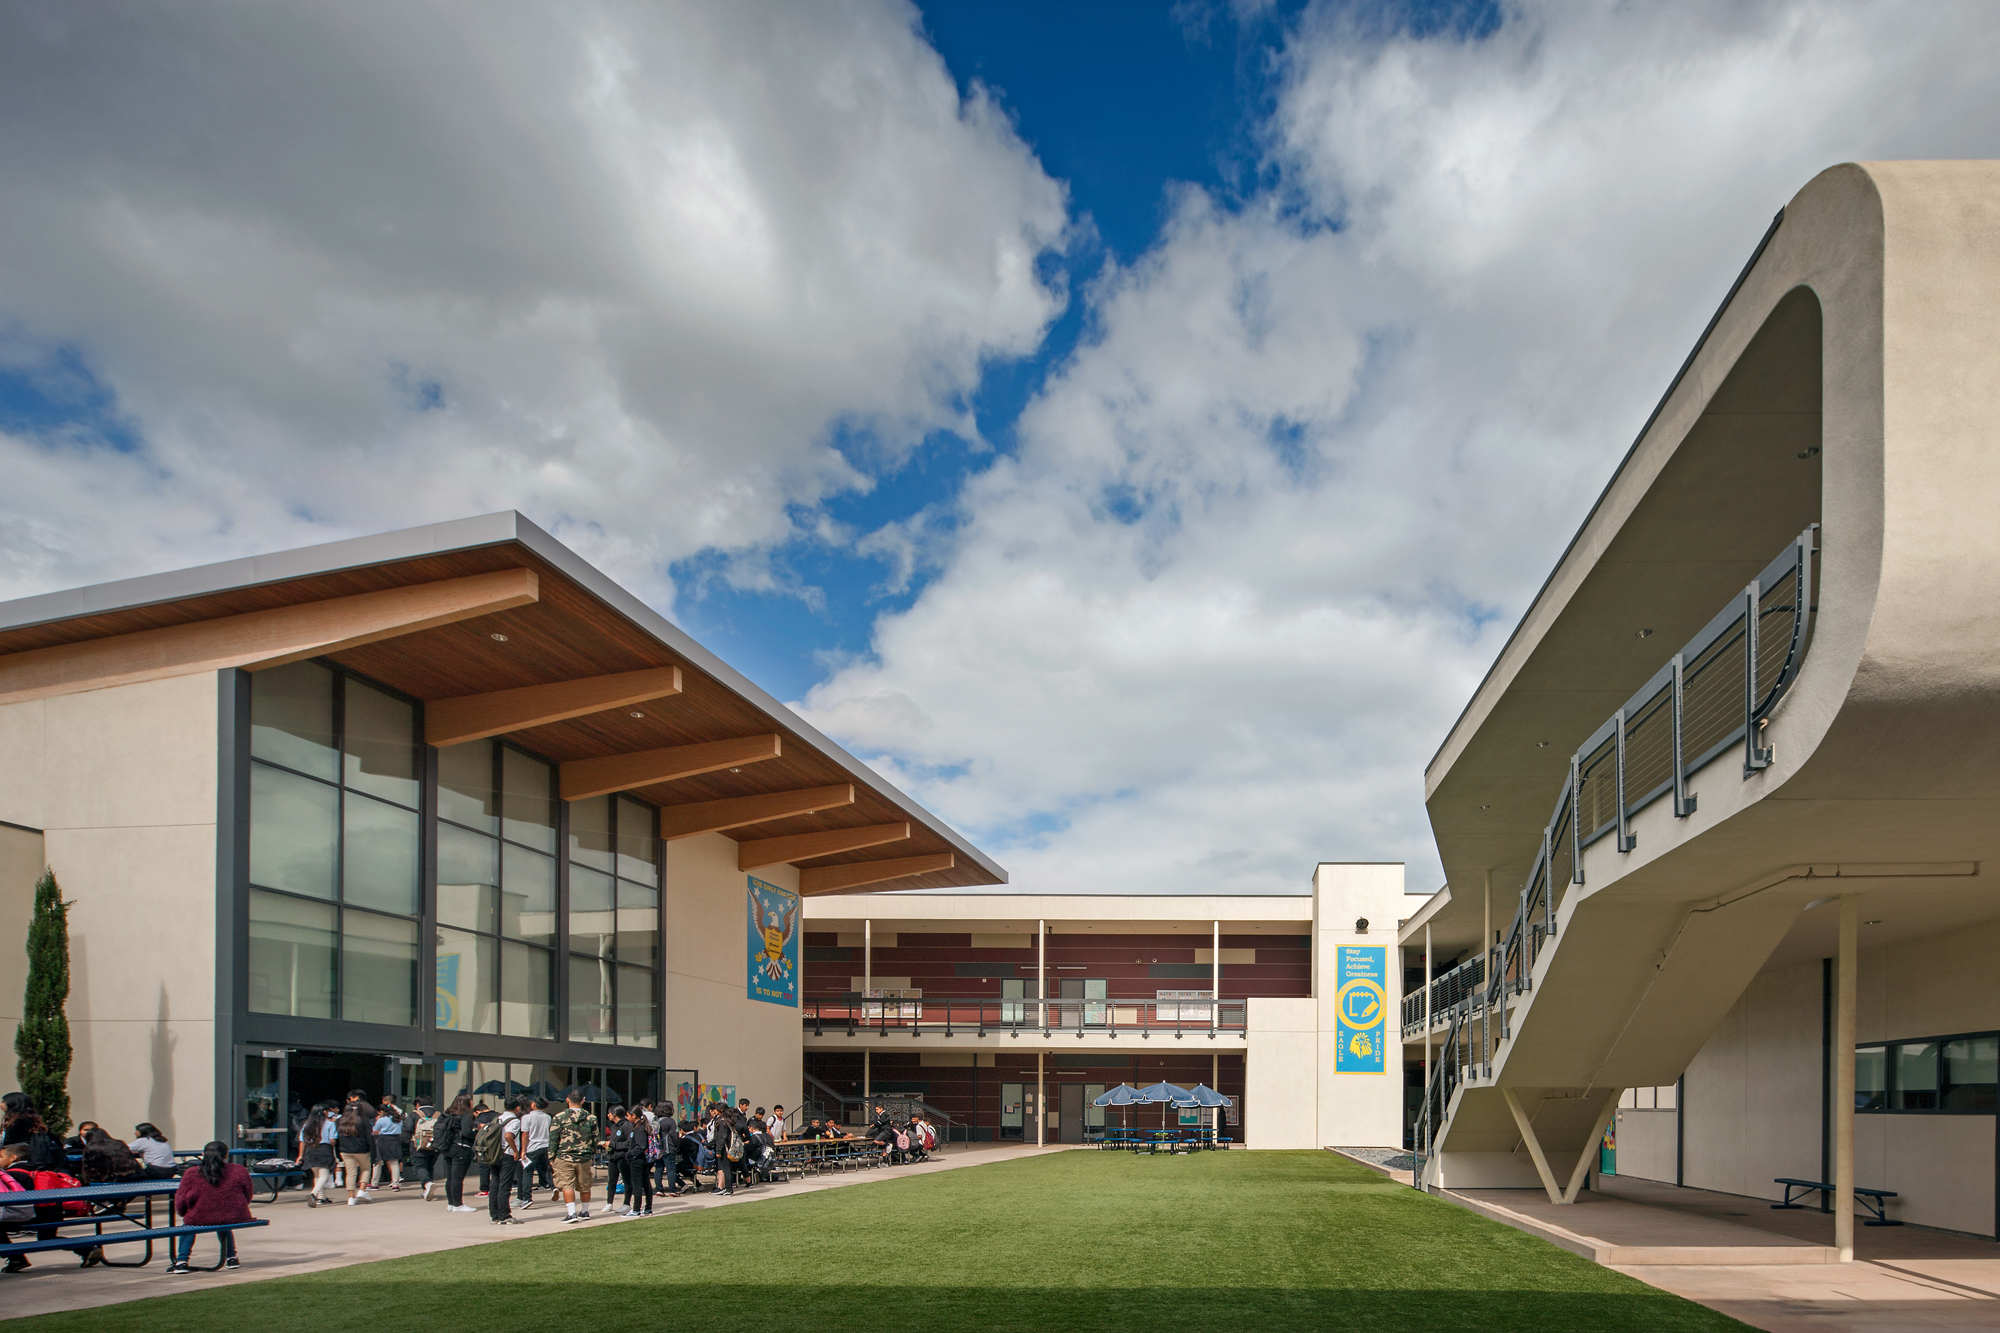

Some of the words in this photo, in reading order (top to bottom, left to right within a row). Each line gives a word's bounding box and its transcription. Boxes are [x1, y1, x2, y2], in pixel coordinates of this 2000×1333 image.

[752, 878, 763, 888] THE
[763, 883, 776, 893] ONLY
[1346, 948, 1361, 956] Stay
[1346, 955, 1375, 963] Focused,
[1368, 981, 1381, 992] High
[756, 987, 762, 995] IS
[763, 988, 770, 996] TO
[771, 990, 782, 999] NOT
[783, 992, 793, 1000] TRY
